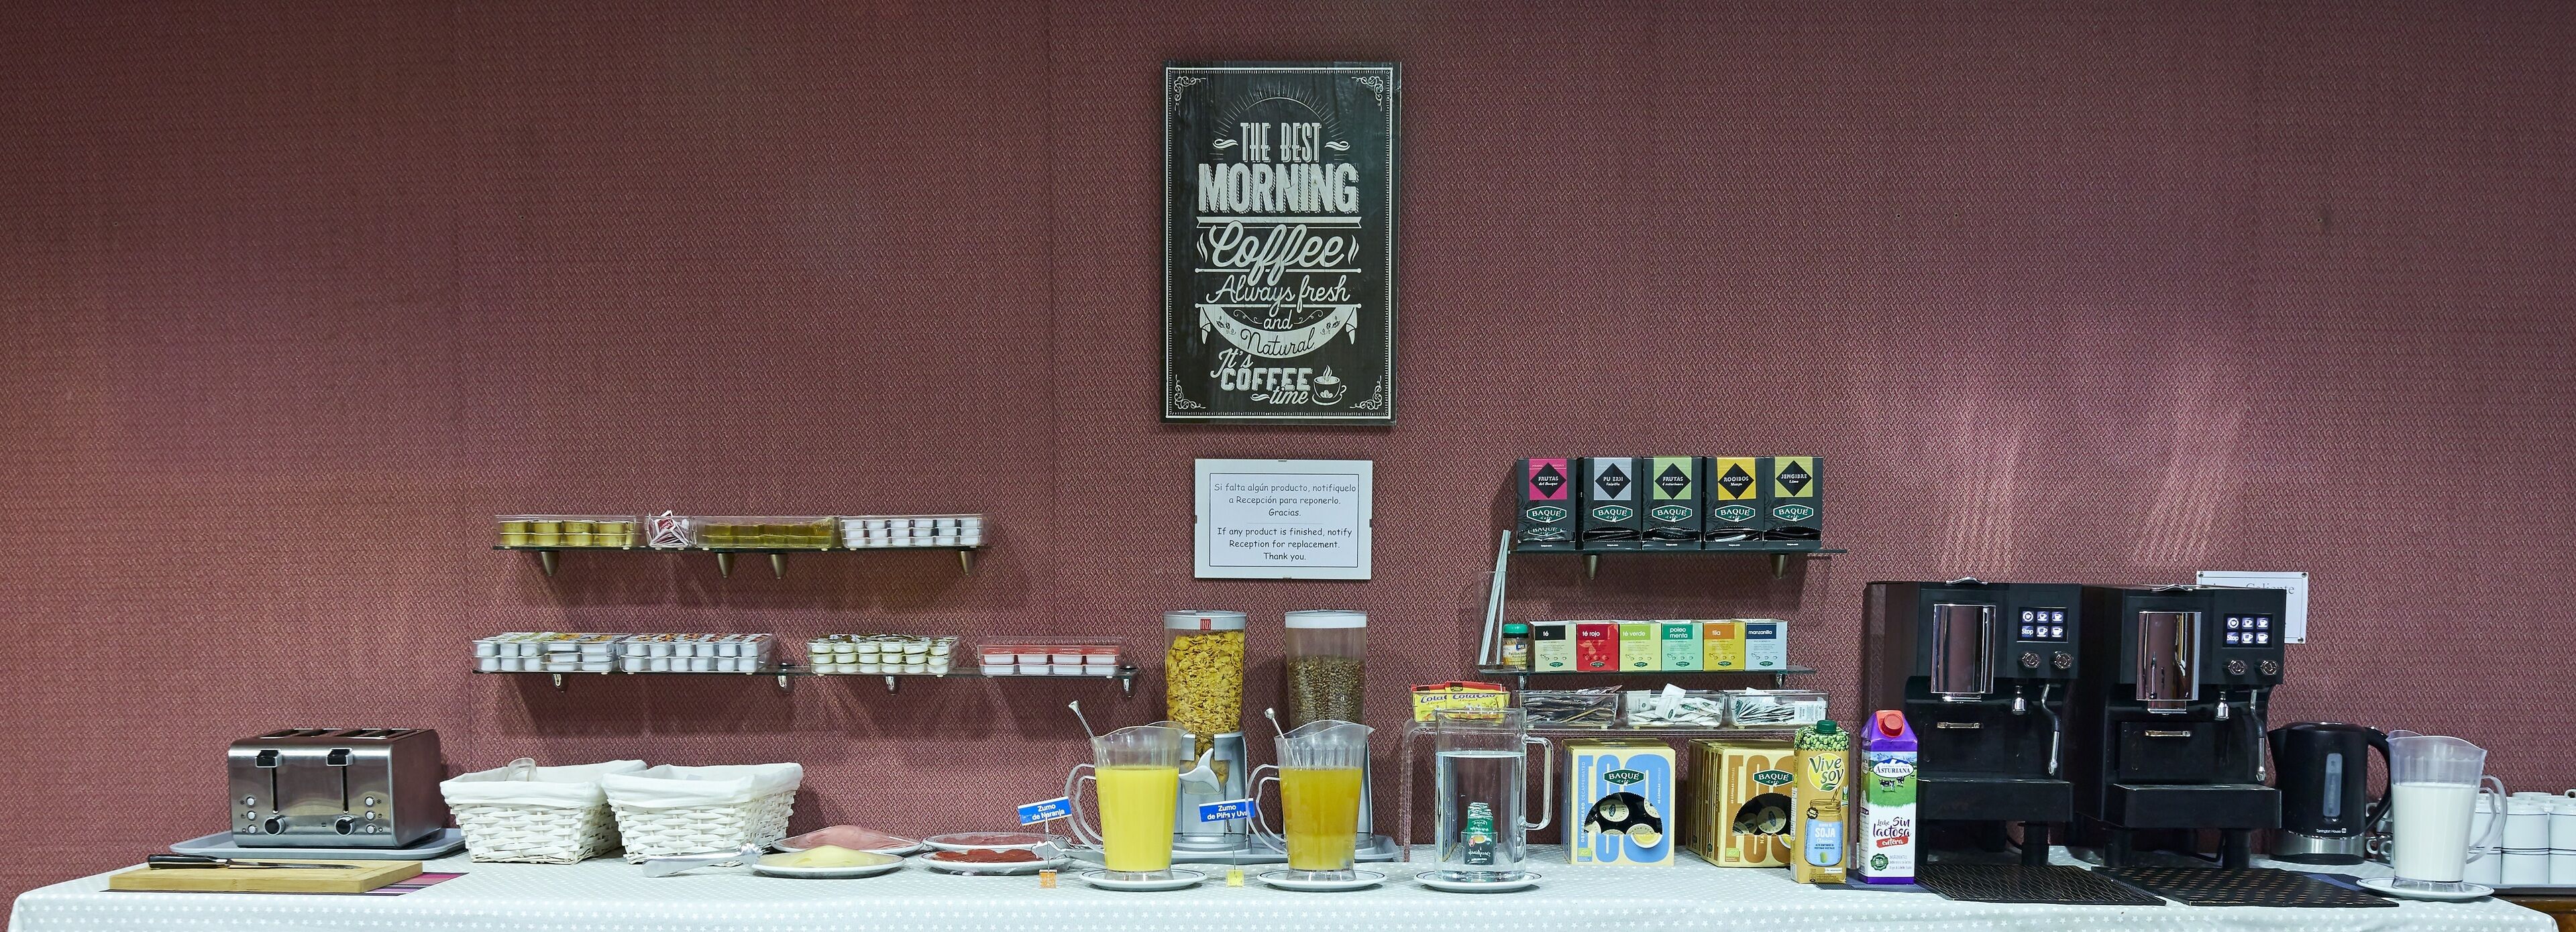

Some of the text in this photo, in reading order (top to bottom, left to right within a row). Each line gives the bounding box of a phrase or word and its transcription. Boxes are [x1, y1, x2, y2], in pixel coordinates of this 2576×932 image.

[1240, 123, 1322, 163] THE BEST
[1198, 163, 1359, 213] MORNING
[1209, 220, 1344, 287] Coffee
[1205, 274, 1350, 316] Always fresh
[1263, 309, 1293, 330] and
[1240, 329, 1316, 356] Natural
[1210, 347, 1253, 379] It's
[1221, 367, 1313, 391] COFFEE
[1270, 384, 1309, 404] time
[1214, 483, 1222, 491] Si
[1226, 483, 1245, 491] falta
[1248, 483, 1269, 493] algún
[1271, 483, 1310, 493] producto,
[1236, 496, 1277, 506] Recepción
[1279, 498, 1297, 506] para
[1299, 497, 1340, 506] reponerlo.
[1658, 508, 1687, 516] BAQUÉ
[1217, 527, 1226, 535] If
[1229, 529, 1242, 537] any
[1246, 528, 1277, 537] product
[1289, 528, 1325, 536] finished,
[1327, 528, 1352, 538] notify
[1229, 540, 1269, 550] Reception
[1288, 540, 1340, 550] replacement.
[1263, 552, 1306, 562] Thank you.
[1809, 756, 1842, 773] Vive
[1609, 772, 1640, 780] BAQUÉ
[1758, 773, 1789, 781] BAQUÉ
[1820, 769, 1843, 785] soy
[1037, 804, 1057, 812] Zumo
[1040, 809, 1065, 818] Naranja
[1892, 817, 1910, 827] Sin
[1815, 827, 1835, 838] SOJA
[1873, 823, 1911, 838] lactosa
